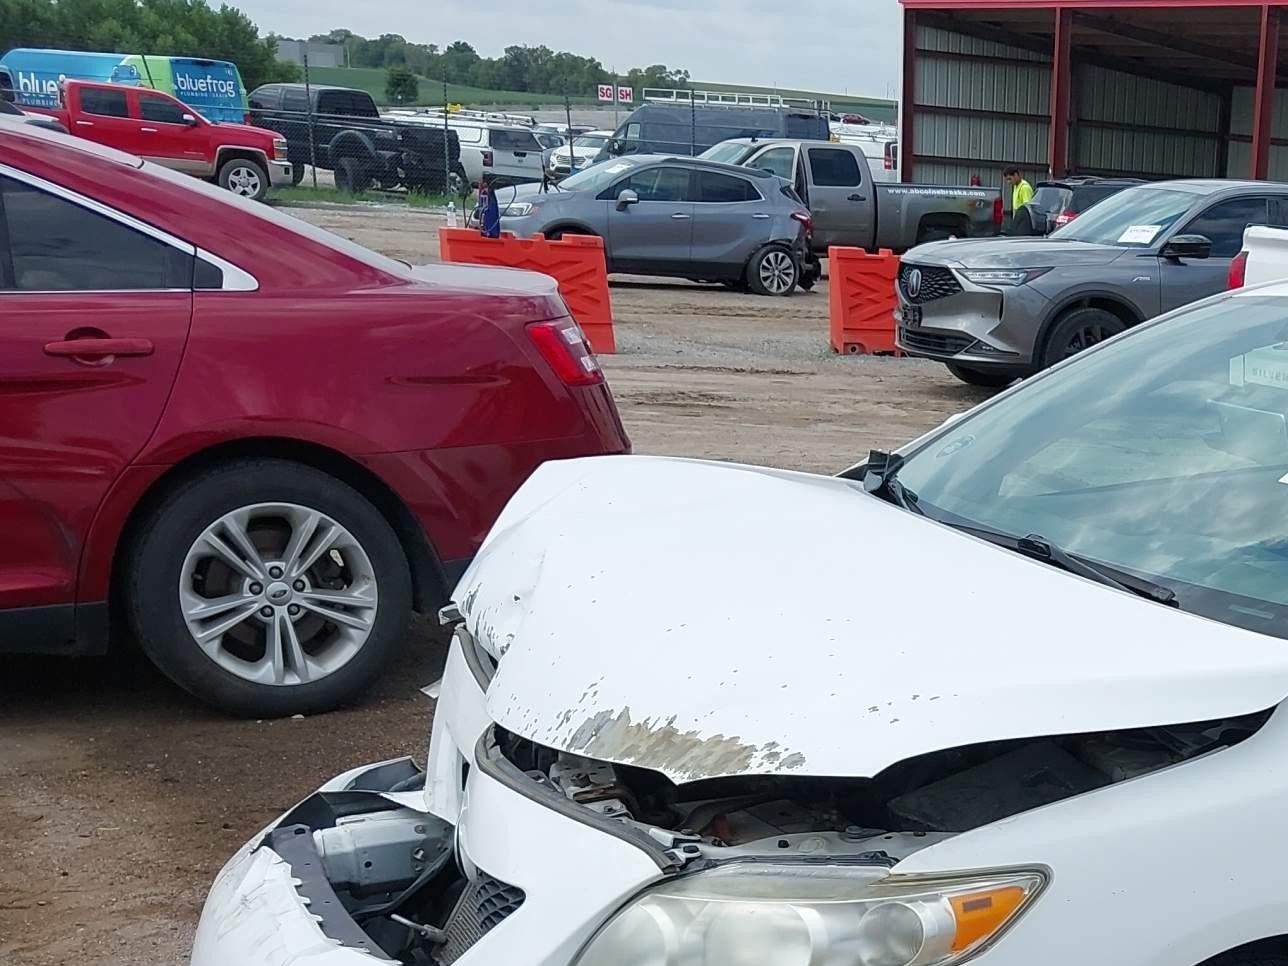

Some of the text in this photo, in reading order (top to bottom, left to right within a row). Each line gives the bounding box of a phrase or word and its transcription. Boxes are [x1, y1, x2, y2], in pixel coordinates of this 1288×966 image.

[18, 71, 58, 98] blue
[176, 72, 236, 97] bluefrog
[599, 87, 612, 99] SG
[619, 89, 632, 101] SH
